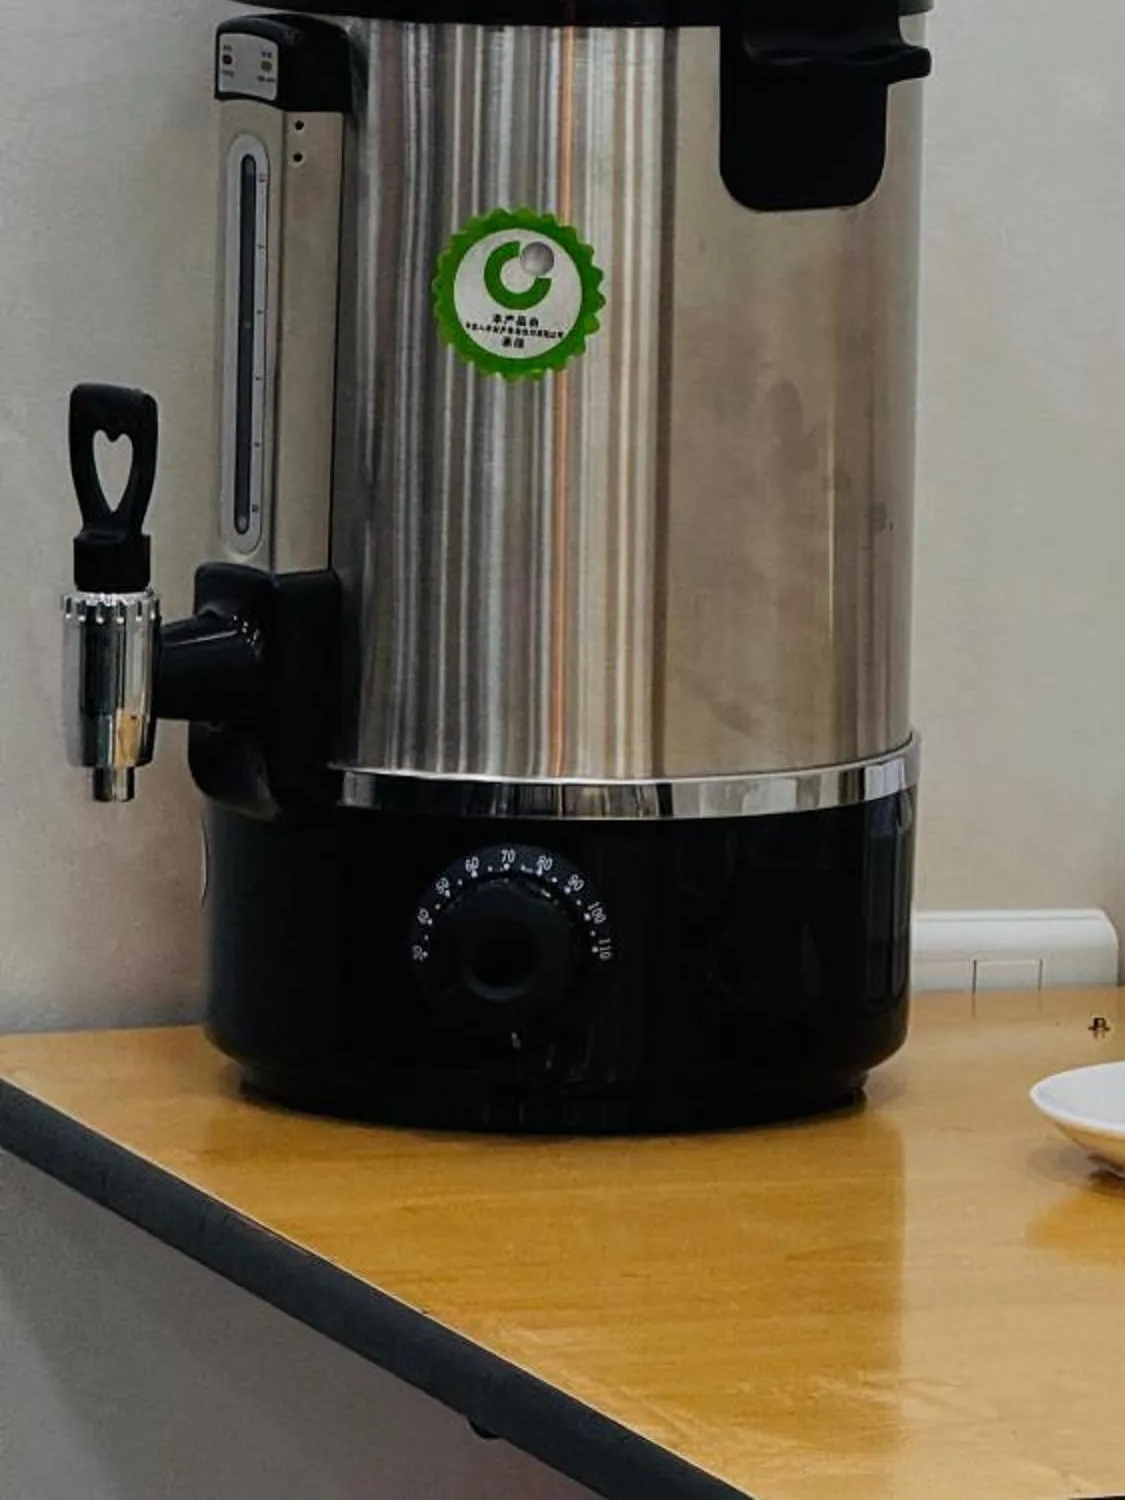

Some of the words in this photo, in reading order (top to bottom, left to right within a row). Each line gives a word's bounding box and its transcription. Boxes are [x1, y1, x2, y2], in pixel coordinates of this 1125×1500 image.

[500, 849, 516, 863] 70
[588, 901, 607, 924] 100
[598, 937, 613, 961] 110
